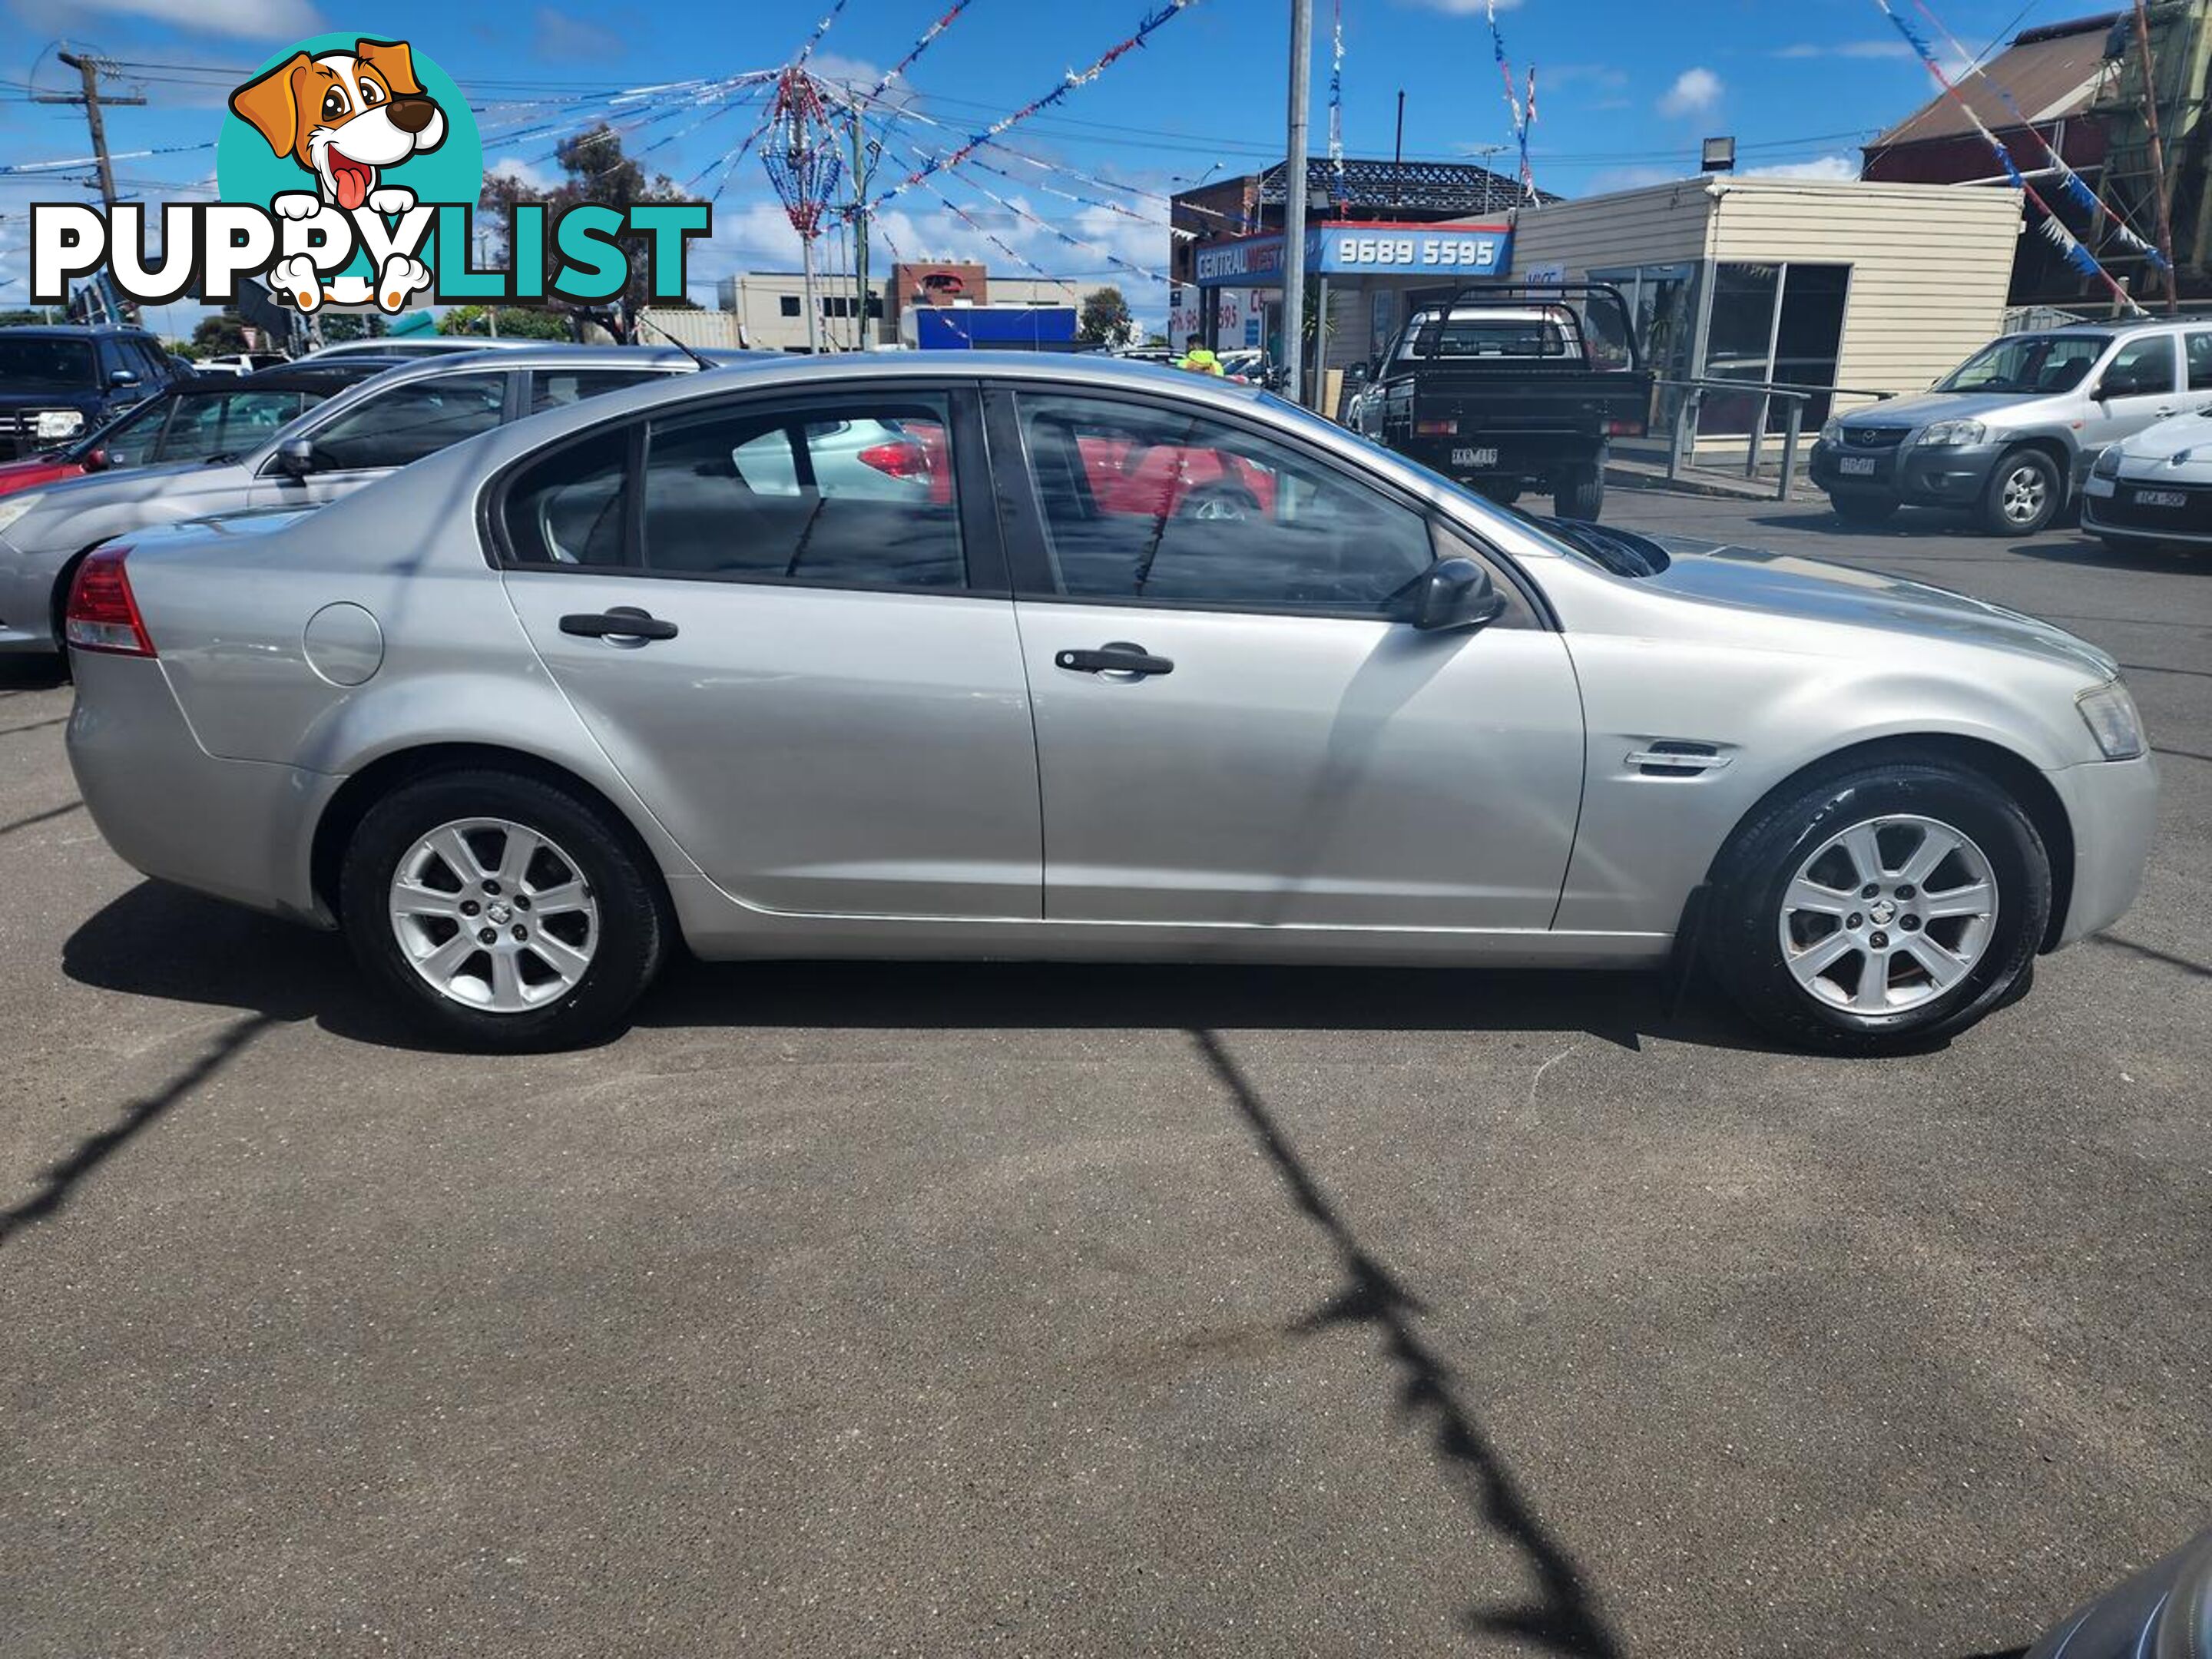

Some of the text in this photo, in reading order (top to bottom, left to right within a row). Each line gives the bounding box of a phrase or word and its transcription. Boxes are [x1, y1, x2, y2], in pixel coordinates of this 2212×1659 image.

[1198, 247, 1247, 279] CENTRAL
[1339, 238, 1412, 263] 9689
[1423, 240, 1494, 265] 5595
